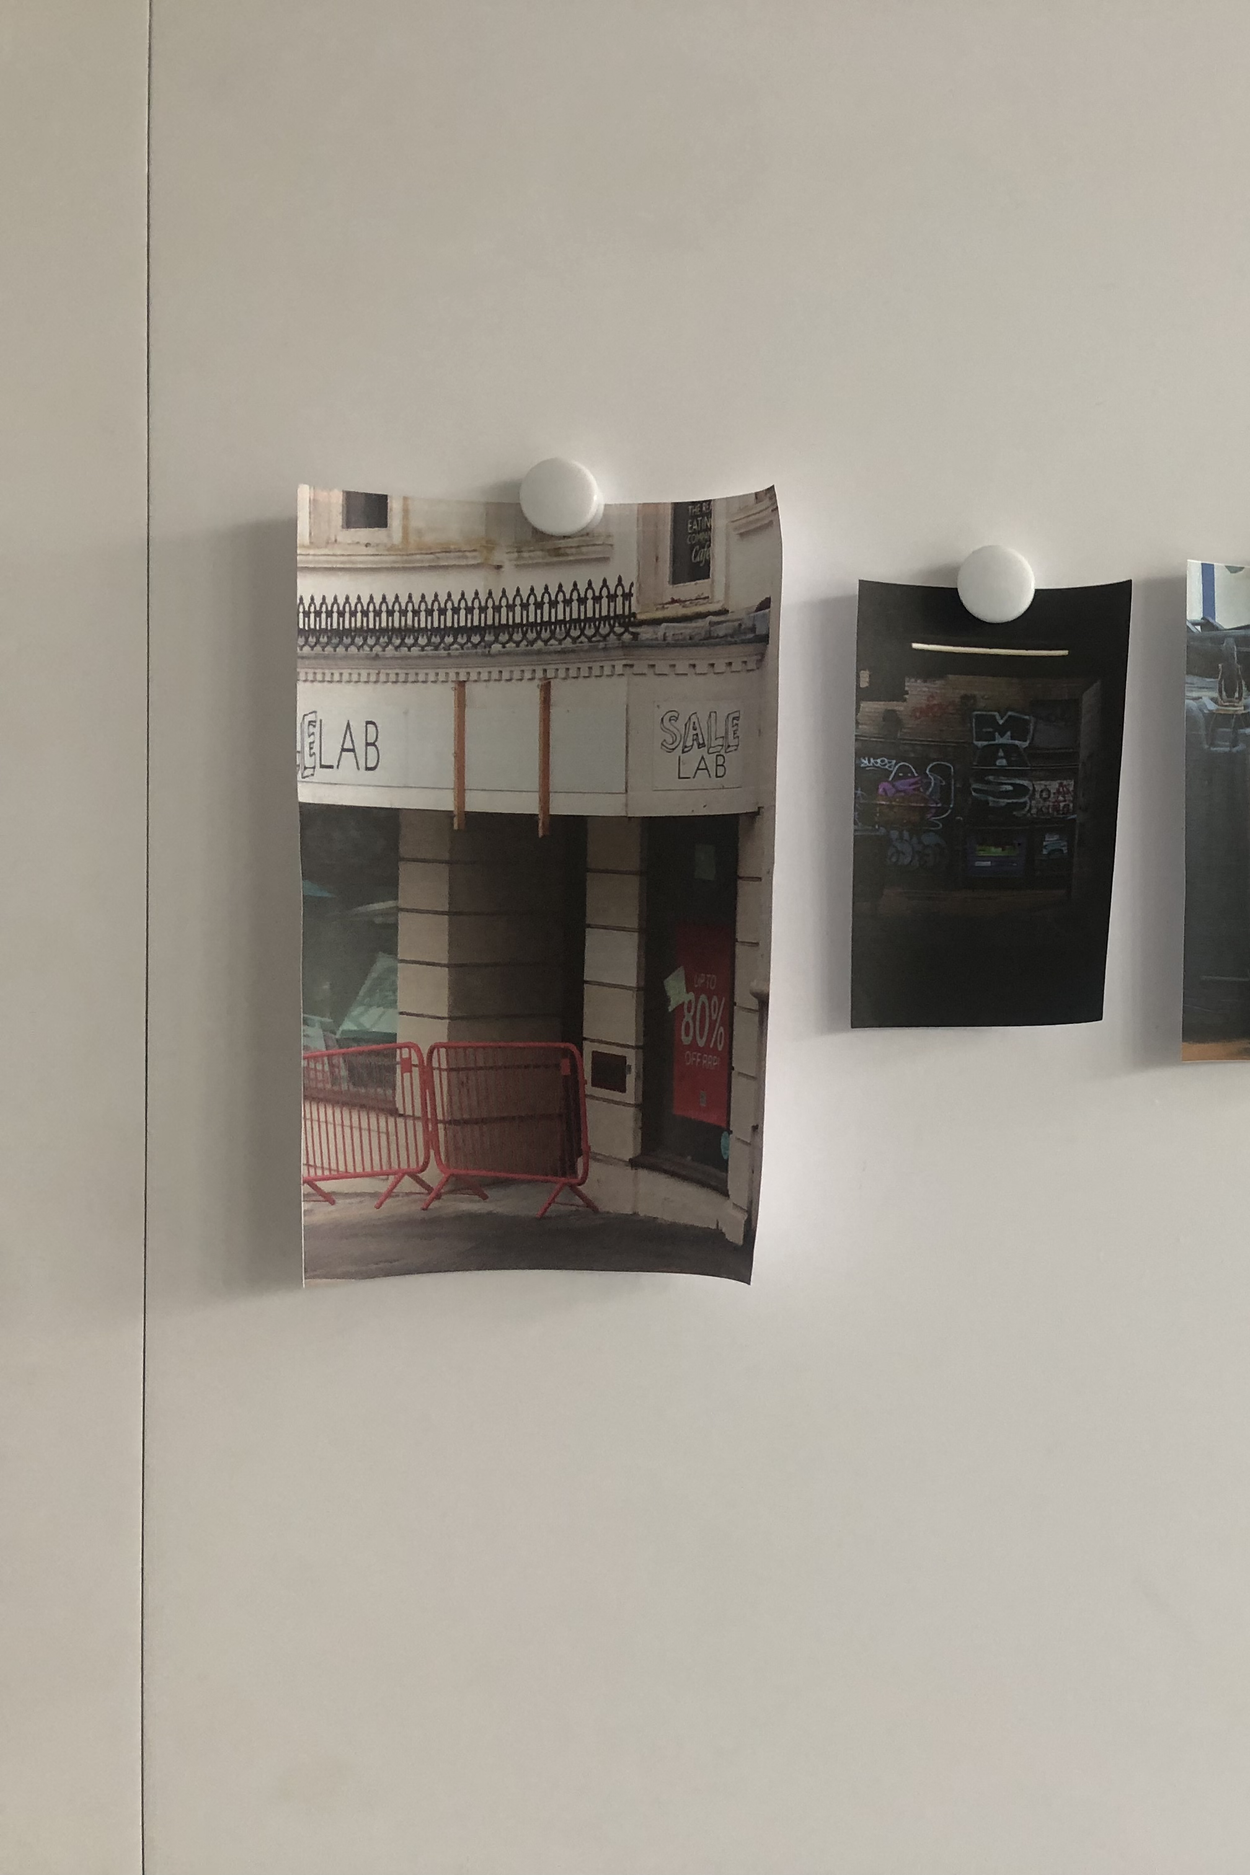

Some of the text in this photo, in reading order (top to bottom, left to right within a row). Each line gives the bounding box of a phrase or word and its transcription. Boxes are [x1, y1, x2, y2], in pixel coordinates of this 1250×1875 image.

[319, 718, 380, 771] LAB
[660, 709, 740, 754] SALE
[678, 754, 726, 780] LAB
[694, 973, 717, 990] UP TO
[681, 992, 725, 1051] 80%
[685, 1051, 701, 1066] OFF
